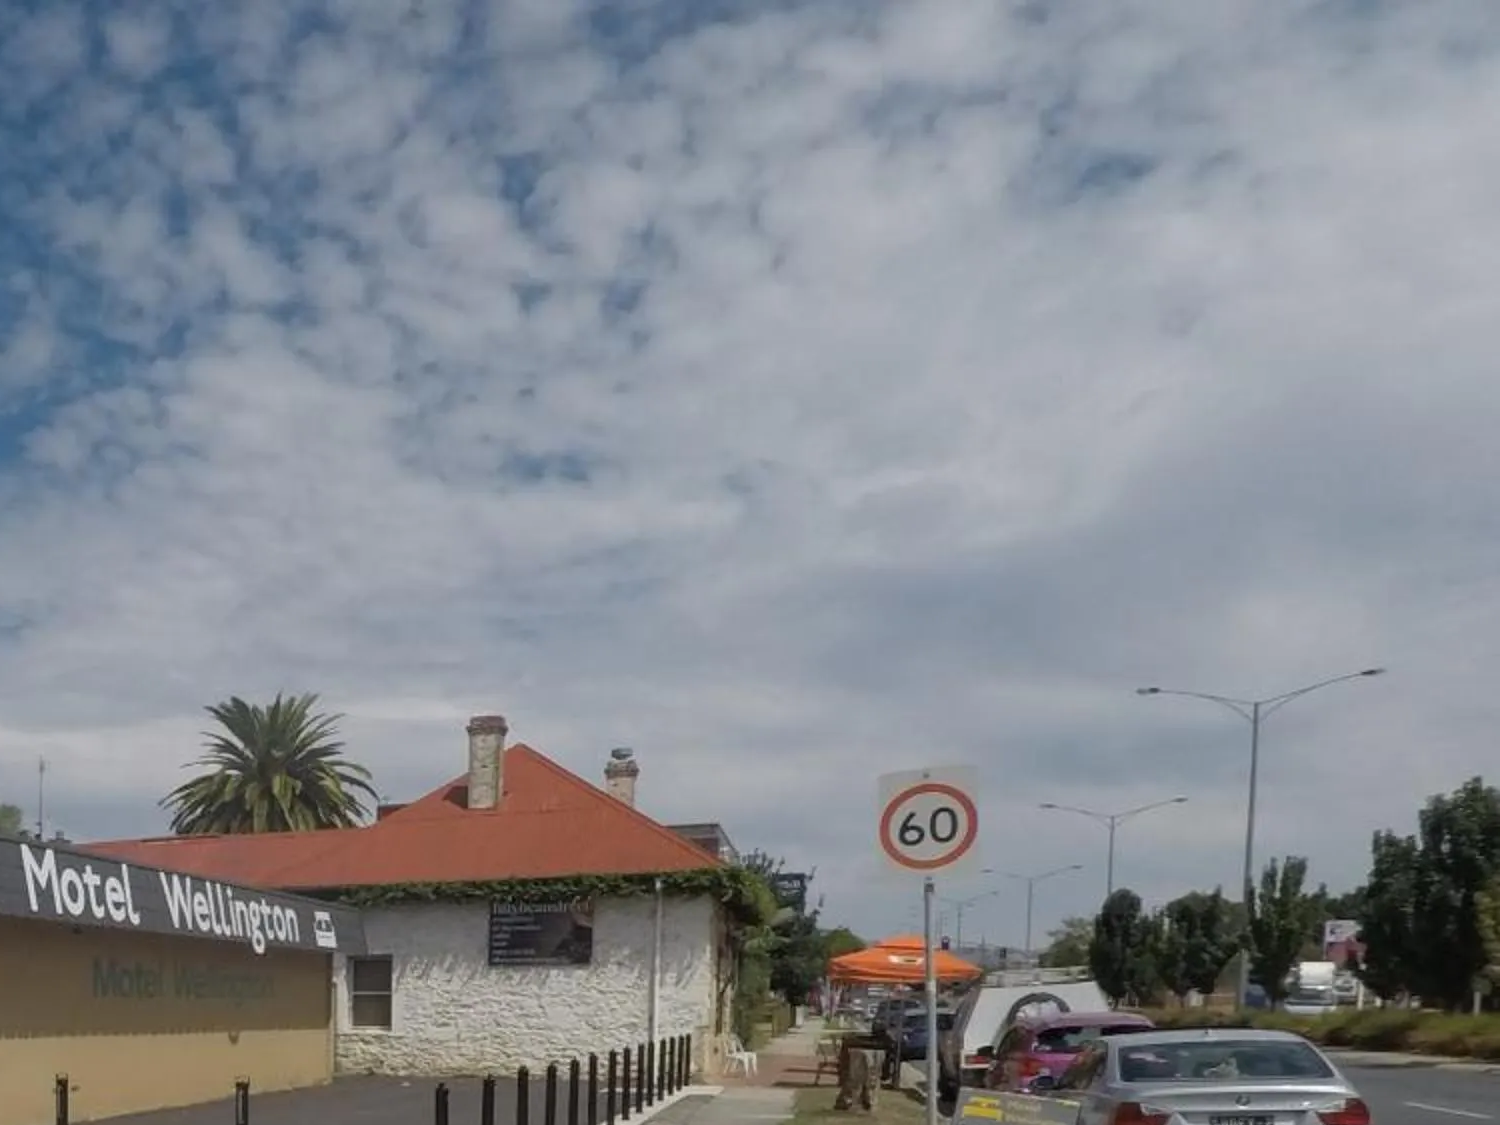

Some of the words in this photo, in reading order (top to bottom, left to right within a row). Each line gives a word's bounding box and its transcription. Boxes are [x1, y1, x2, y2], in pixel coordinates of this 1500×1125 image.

[898, 806, 959, 847] 60
[19, 842, 141, 927] Motel
[159, 870, 301, 956] Wellington
